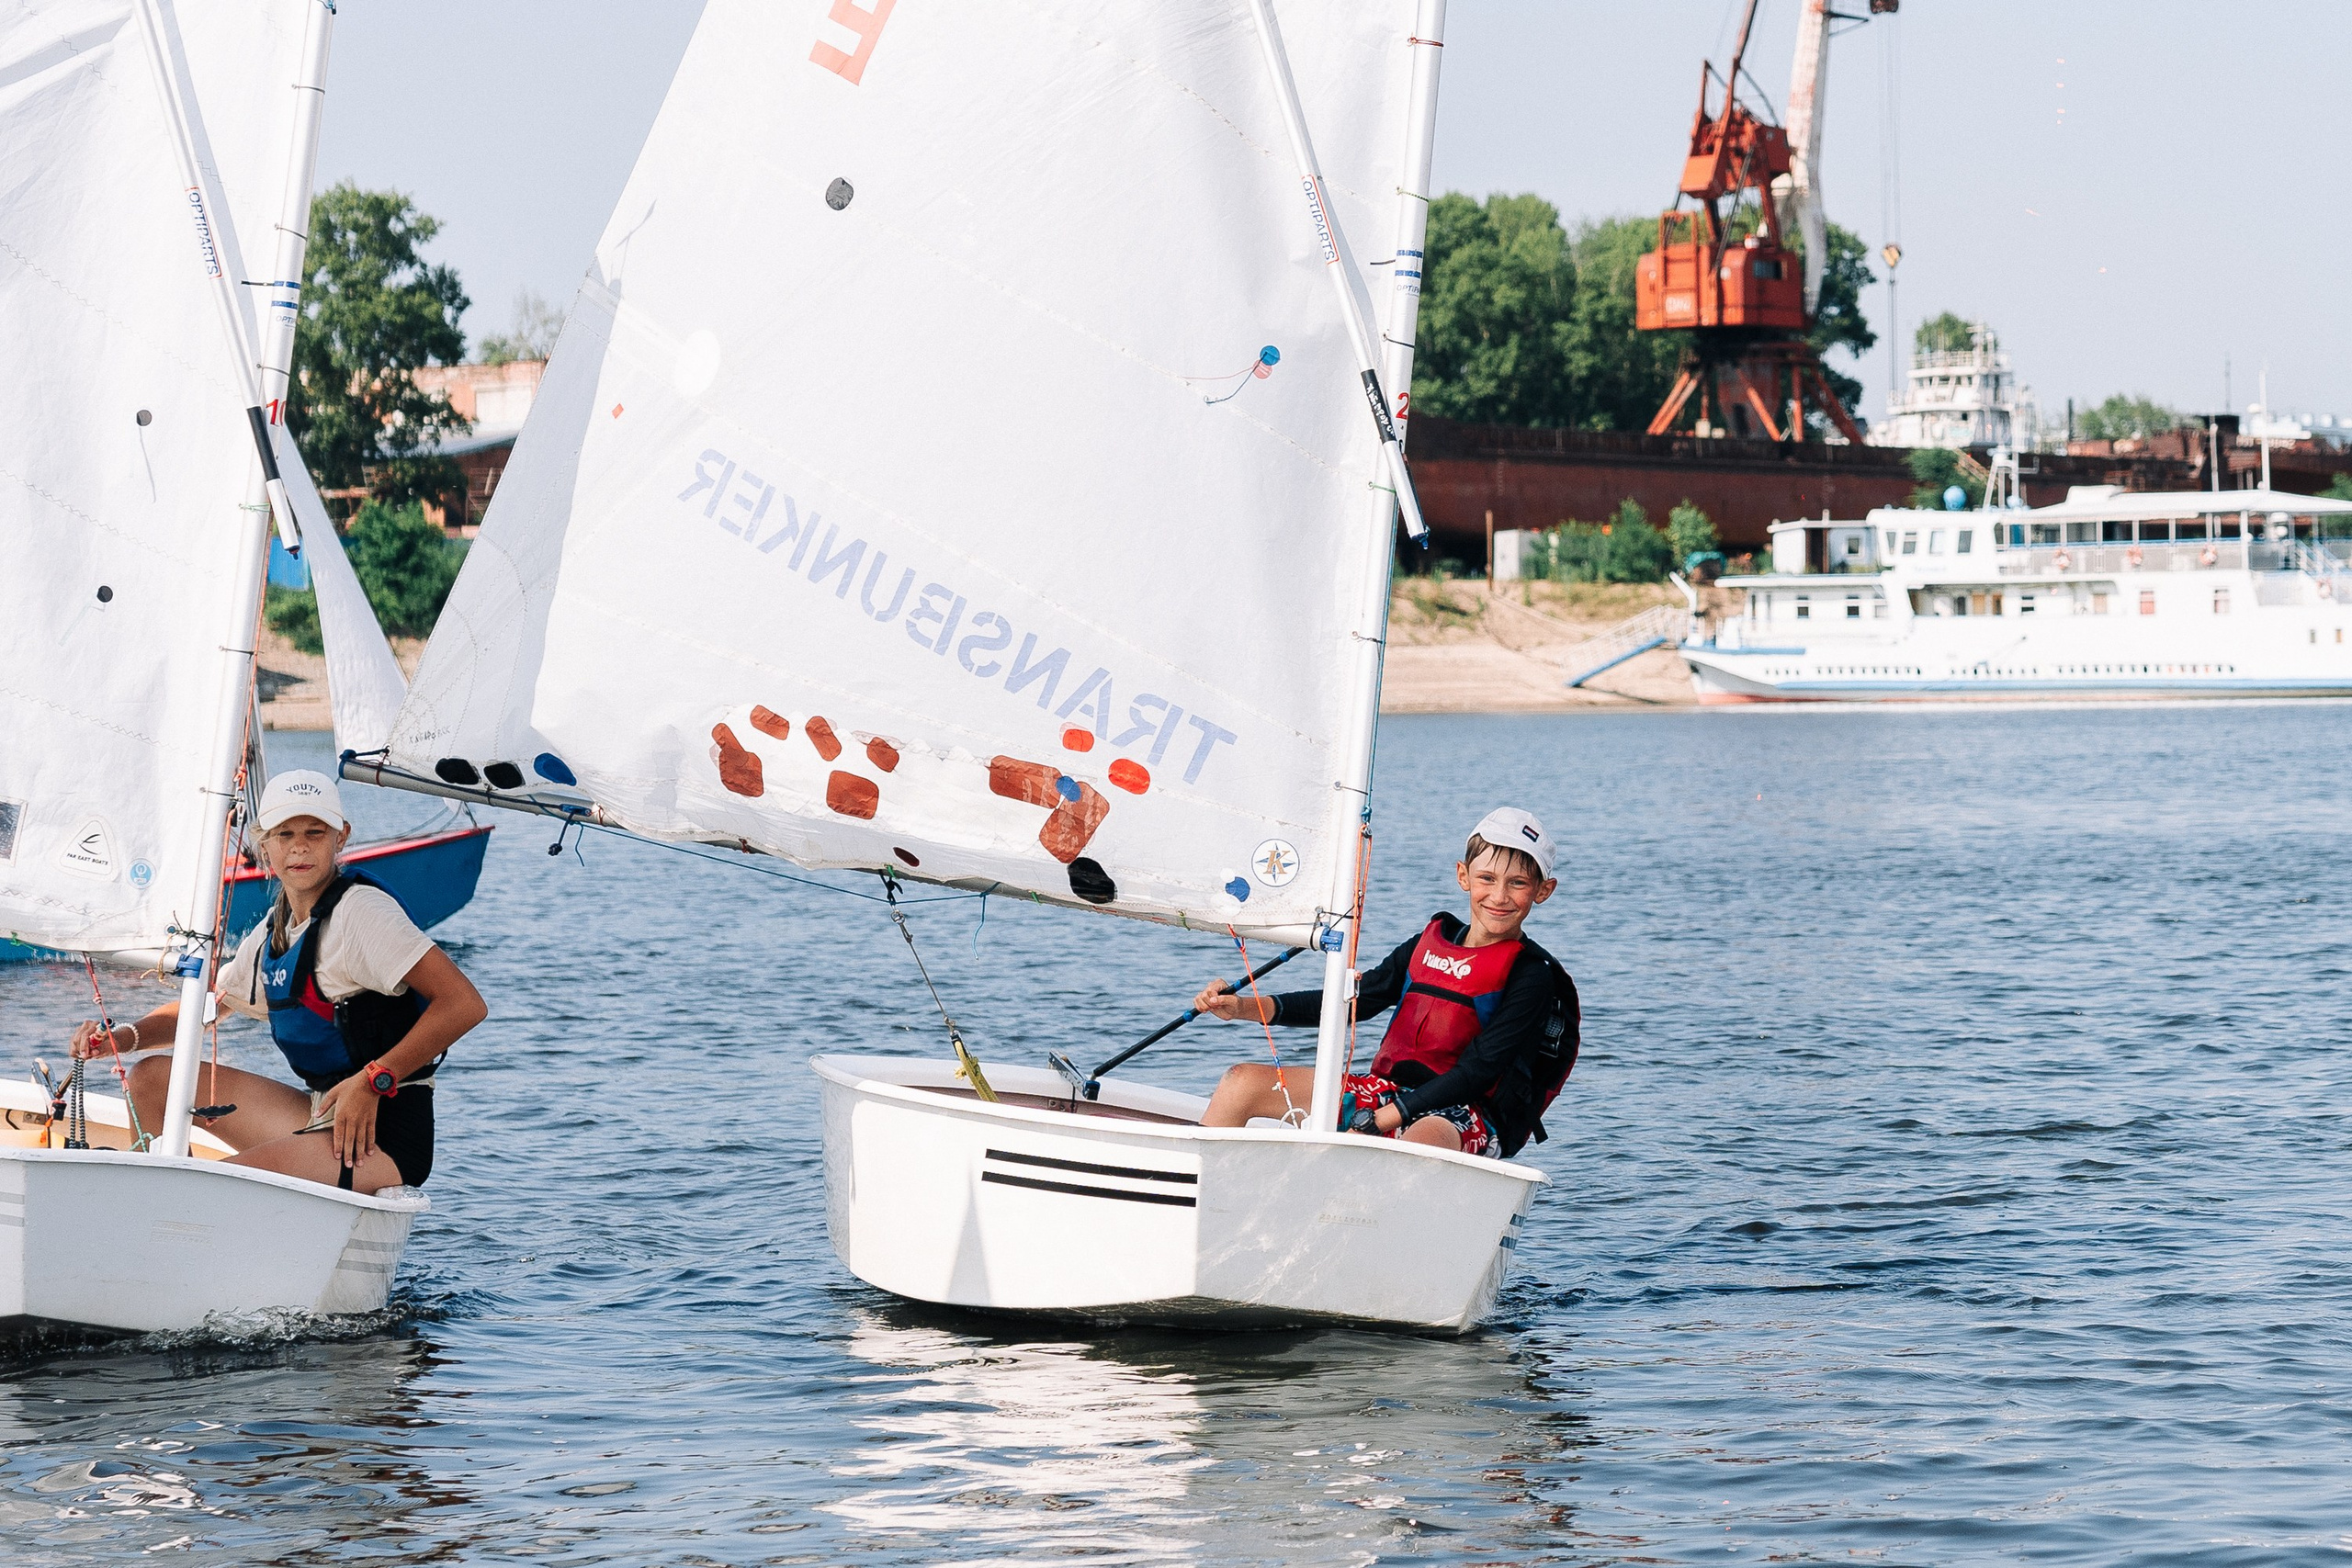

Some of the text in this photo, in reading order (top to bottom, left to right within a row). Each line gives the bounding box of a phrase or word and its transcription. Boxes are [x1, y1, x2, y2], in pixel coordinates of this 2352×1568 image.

[187, 191, 220, 276] OPTIPARTS
[1302, 179, 1336, 262] OPTIPARTS
[1396, 392, 1409, 420] 2
[286, 784, 322, 795] YOUTH
